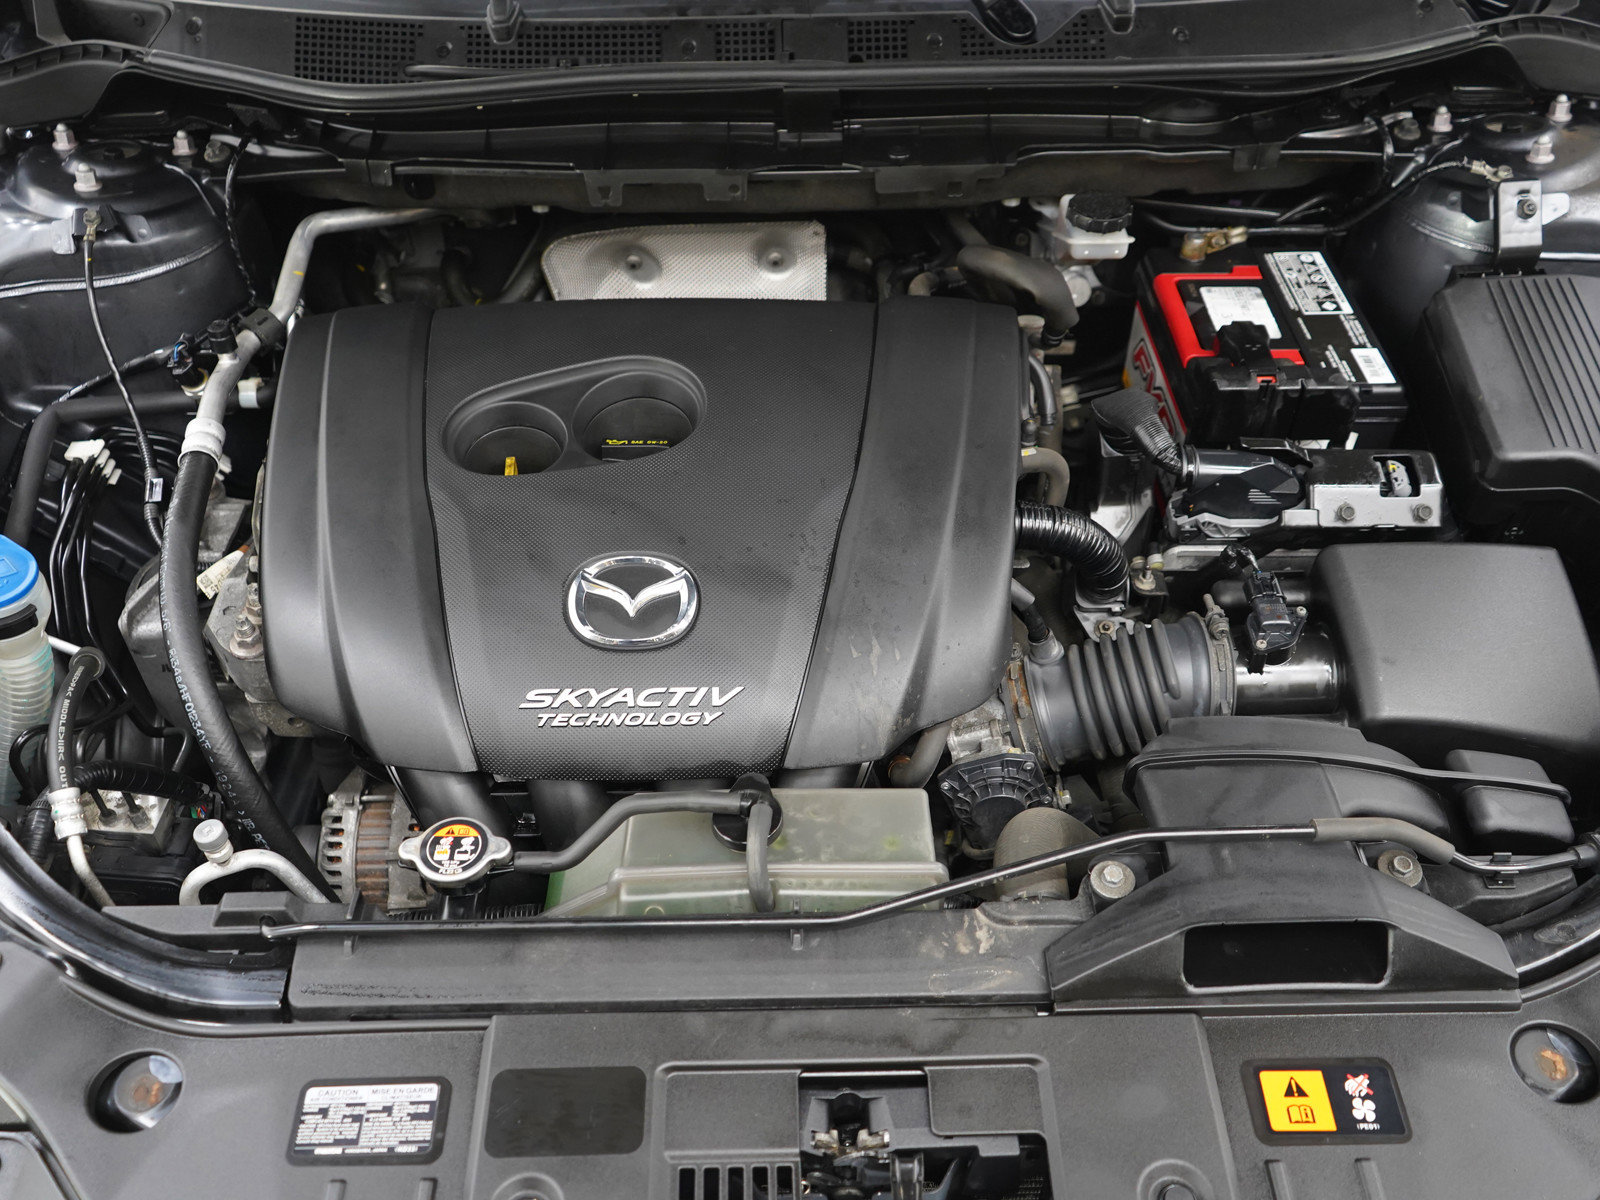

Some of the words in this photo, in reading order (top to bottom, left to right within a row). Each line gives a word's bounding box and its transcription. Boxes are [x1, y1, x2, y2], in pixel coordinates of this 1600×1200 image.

[518, 686, 745, 709] SKYACTIV
[537, 711, 724, 727] TECHNOLOGY
[406, 1086, 434, 1094] GARDE
